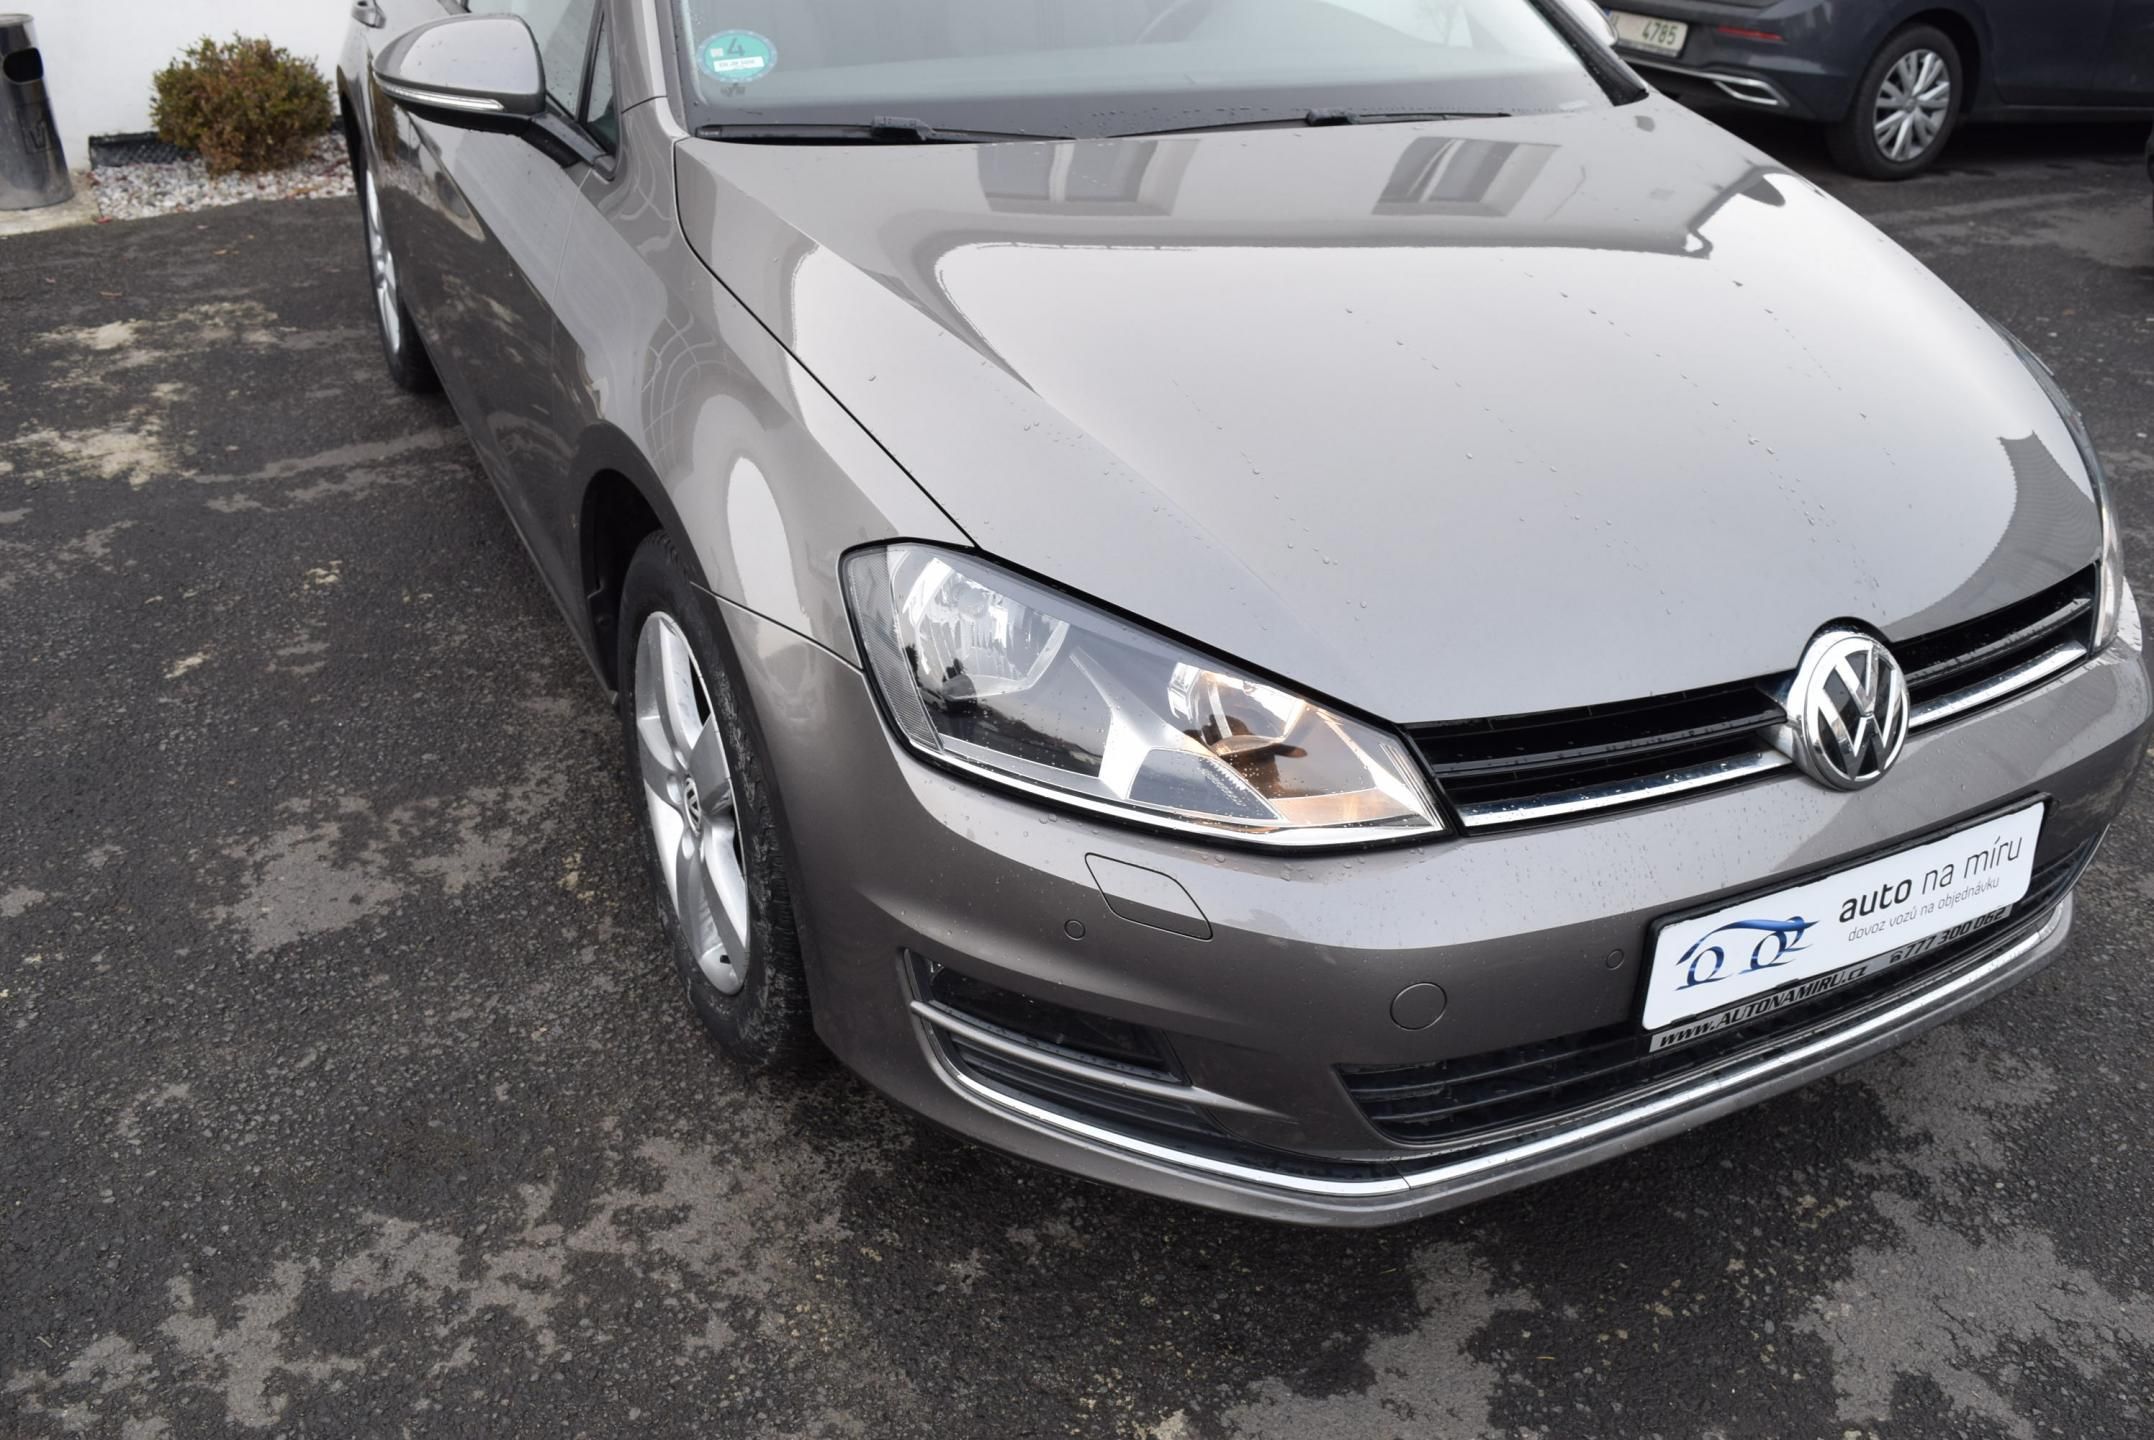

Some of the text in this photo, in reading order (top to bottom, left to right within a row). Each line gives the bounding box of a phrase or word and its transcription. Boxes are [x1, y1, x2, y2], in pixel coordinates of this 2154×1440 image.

[727, 37, 745, 56] 4
[1642, 20, 1678, 45] 4785
[1808, 638, 1907, 786] VW
[1839, 836, 2023, 923] auto na míru
[1848, 877, 2000, 942] dovoz vozů na objednávku
[1937, 921, 1972, 945] 300
[1973, 907, 2007, 930] 062
